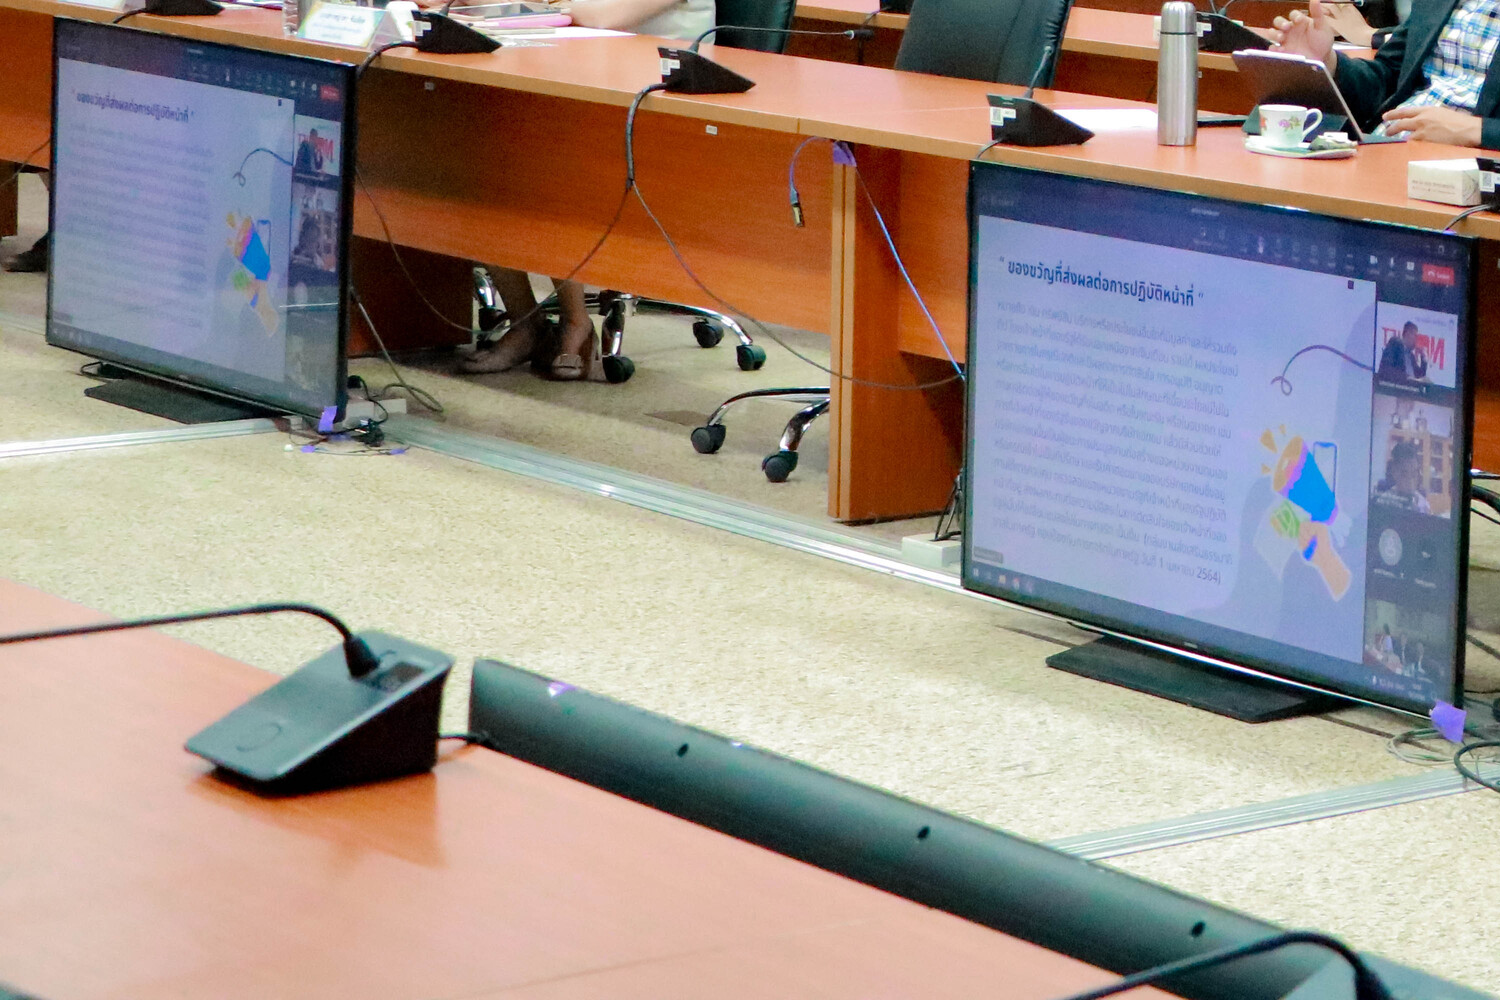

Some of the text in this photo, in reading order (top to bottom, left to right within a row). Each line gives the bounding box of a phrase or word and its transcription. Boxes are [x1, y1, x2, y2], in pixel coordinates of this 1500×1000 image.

[1008, 259, 1194, 306] ของขวัญที่ส่งผลต่อการปฏิบัติหน้าที่
